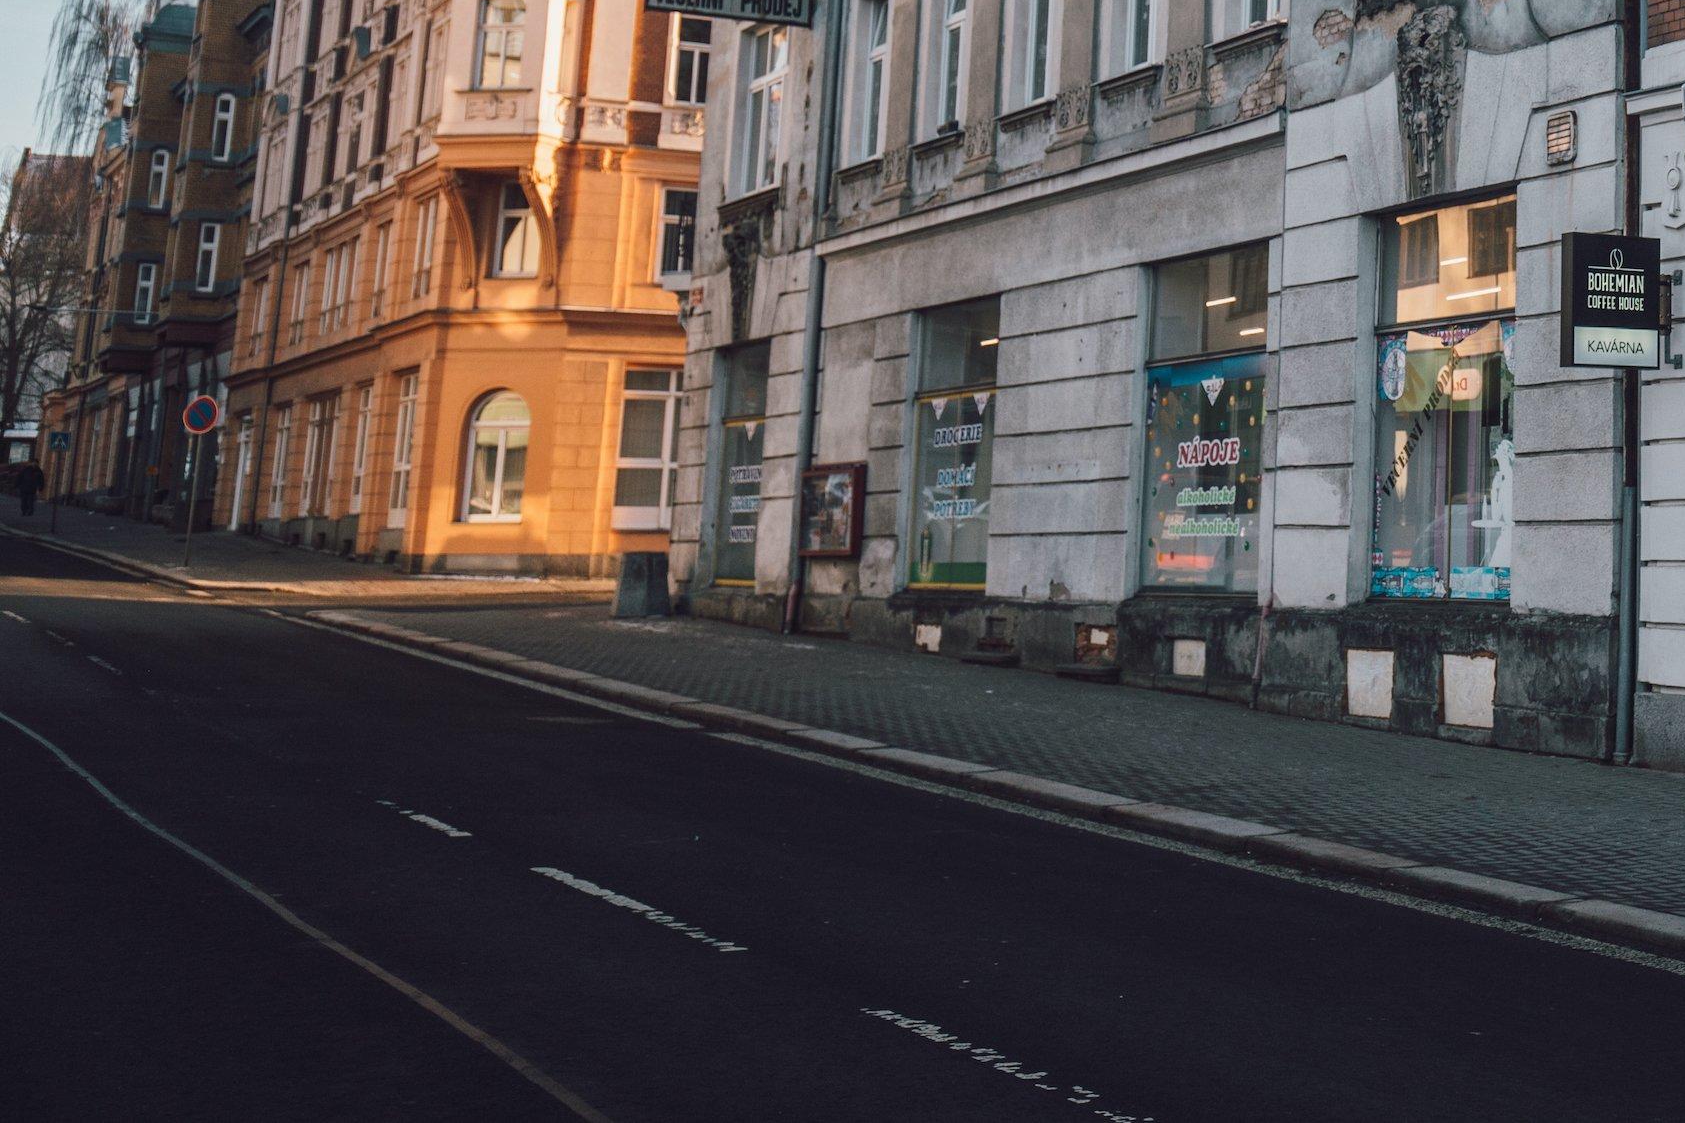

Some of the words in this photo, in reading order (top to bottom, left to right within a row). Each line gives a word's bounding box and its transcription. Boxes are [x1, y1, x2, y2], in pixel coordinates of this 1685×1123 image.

[1587, 272, 1645, 294] BOHEMIAN
[1587, 294, 1617, 310] COFFEE
[1618, 296, 1645, 312] HOUSE
[1587, 338, 1645, 354] KAVÁRNA
[1177, 435, 1240, 467] NÁPOJE
[1381, 418, 1424, 497] VEČERNÍ
[1176, 486, 1236, 506] alkoholické
[1168, 518, 1239, 536] nealkoholické
